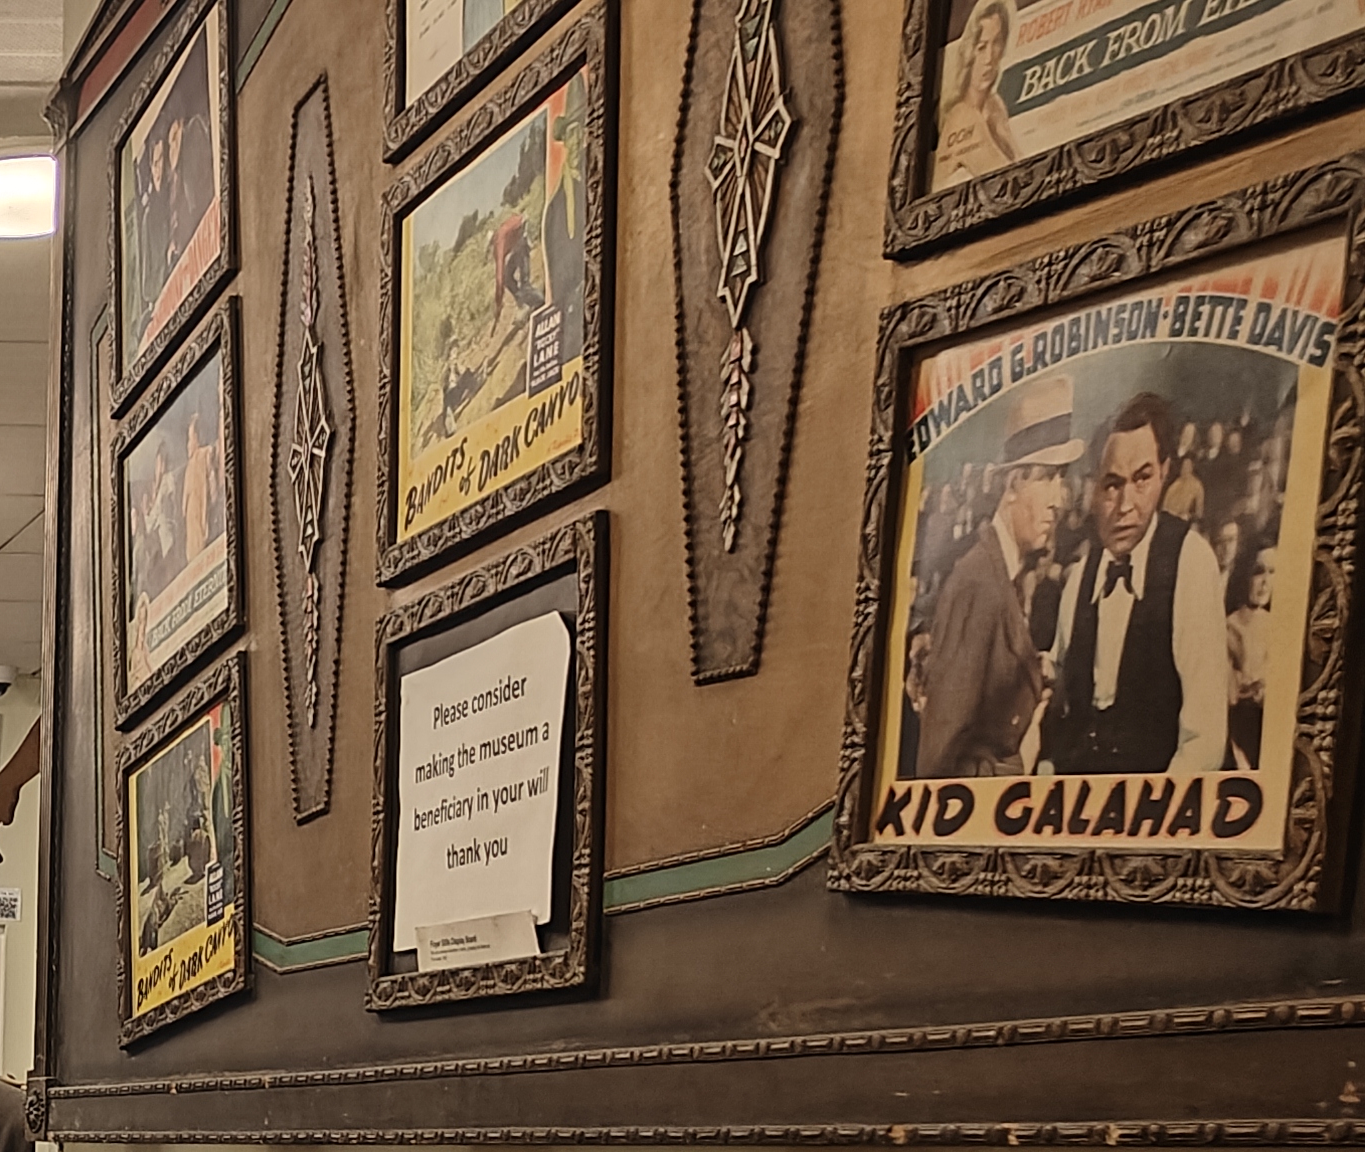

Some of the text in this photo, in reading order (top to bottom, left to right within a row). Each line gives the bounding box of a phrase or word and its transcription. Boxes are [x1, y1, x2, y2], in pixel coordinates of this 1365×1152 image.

[1017, 39, 1099, 104] BACK
[1099, 5, 1187, 68] FROM
[533, 341, 559, 368] LANE
[535, 310, 562, 339] ALLAN
[1031, 297, 1164, 375] ROBINSON
[1168, 294, 1249, 342] BETTE
[1249, 300, 1337, 368] DAVIS
[404, 371, 580, 532] BANDITS of DARK CANYO
[433, 675, 527, 730] Please consider
[414, 721, 550, 784] making the museum a
[413, 765, 550, 832] beneficiary in your will
[876, 776, 1263, 839] KID GALAHAD
[446, 836, 508, 870] thank you
[137, 948, 174, 1011] BANDITS
